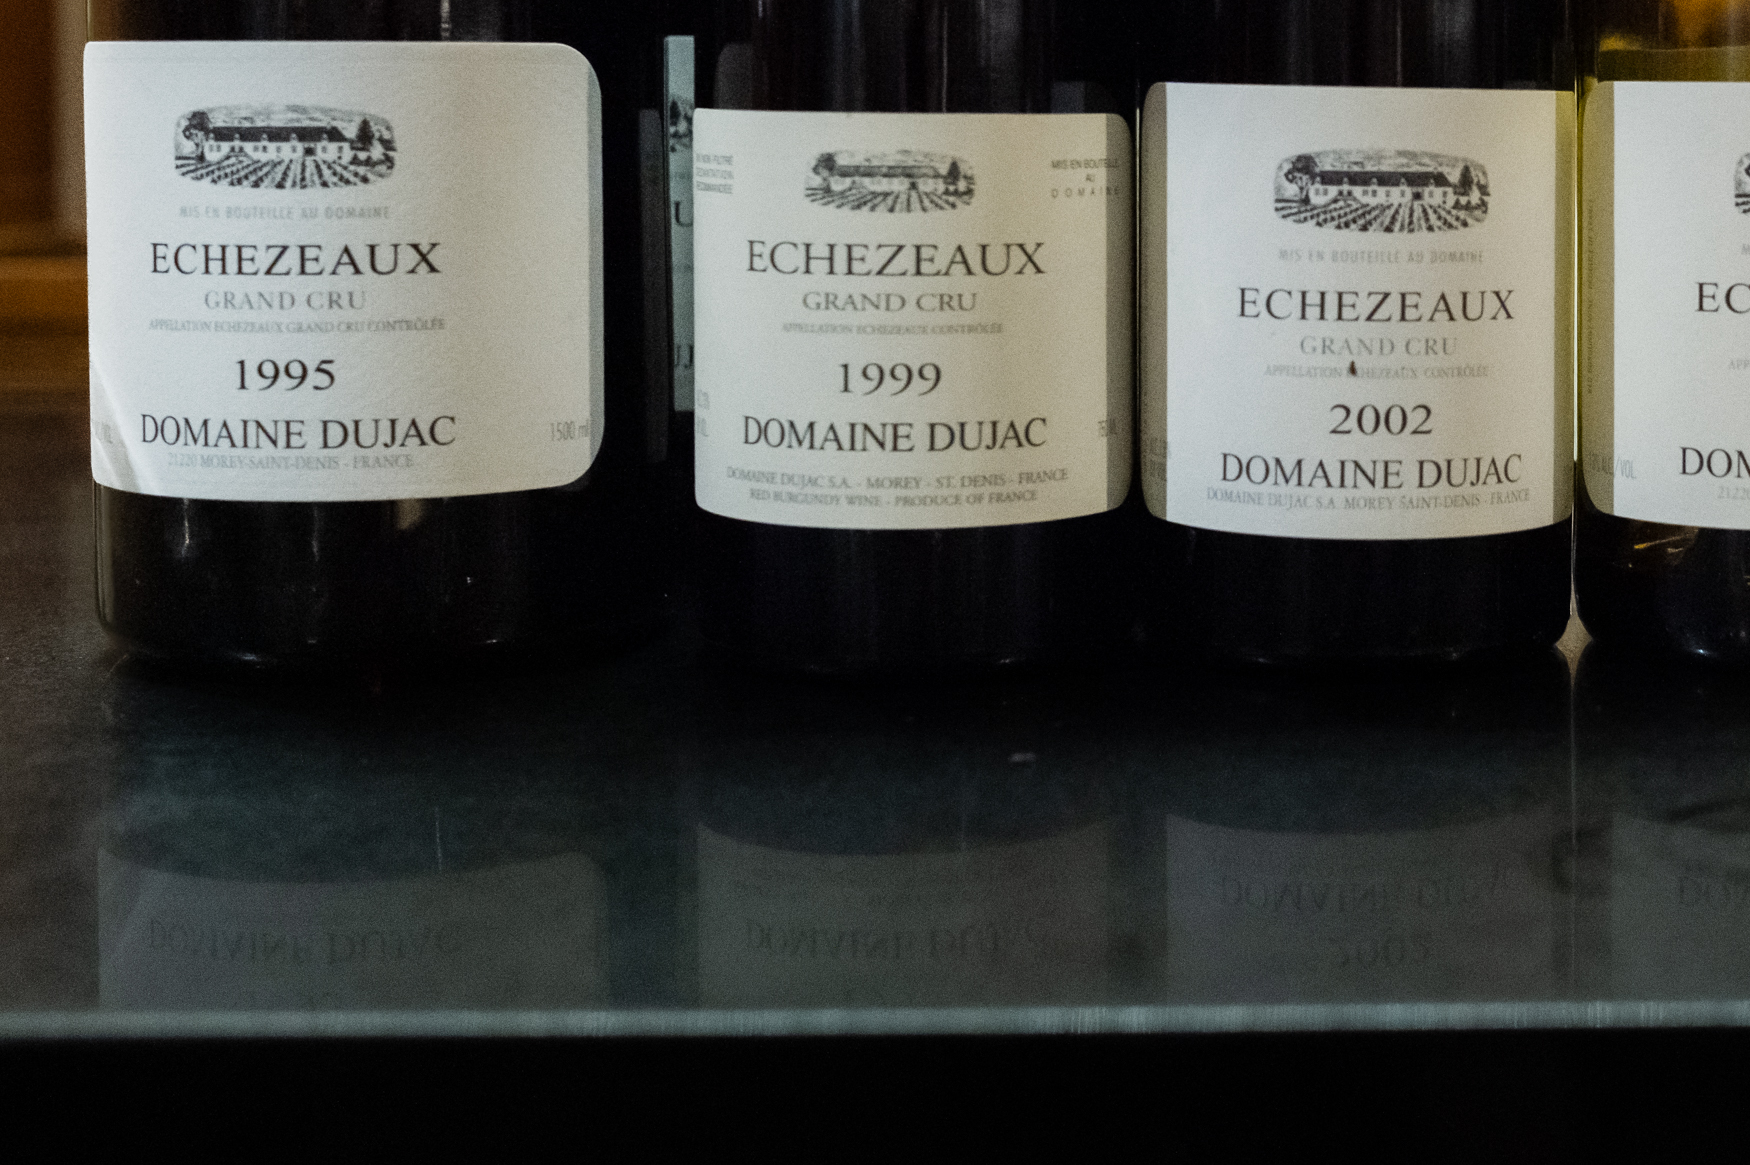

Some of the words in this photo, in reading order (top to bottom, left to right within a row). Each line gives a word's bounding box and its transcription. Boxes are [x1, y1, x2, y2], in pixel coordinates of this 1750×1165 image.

[150, 242, 441, 275] ECHEZEAUX
[746, 239, 1046, 276] ECHEZEAUX
[1279, 248, 1302, 262] MIS
[1331, 249, 1400, 264] BOUTEILLE
[1430, 250, 1484, 264] DOMAINE
[204, 289, 296, 311] GRAND
[306, 289, 367, 311] CRU
[802, 291, 907, 312] GRAND
[915, 292, 977, 312] CRU
[1238, 287, 1515, 323] ECHEZEAUX
[1300, 335, 1395, 357] GRAND
[1404, 336, 1457, 357] CRU
[236, 359, 337, 391] 1995
[839, 362, 942, 396] 1999
[140, 413, 306, 450] DOMAINE
[321, 415, 456, 450] DUJAC
[743, 416, 915, 453] DOMAINE
[927, 417, 1047, 453] DUJAC
[1329, 403, 1433, 436] 2002
[353, 453, 414, 469] FRANCE
[1221, 452, 1404, 490] DOMAINE
[1416, 453, 1524, 490] DUJAC
[726, 465, 777, 487] DOMAINE
[781, 471, 825, 490] DUJAC
[867, 476, 921, 491] MOREY
[960, 473, 1006, 489] DENIS
[1018, 467, 1069, 486] FRANCE
[750, 488, 771, 502] RED
[846, 493, 881, 507] WINE
[966, 492, 986, 506] OF
[988, 488, 1037, 505] FRANCE
[1206, 486, 1264, 506] DOMAINE
[1267, 492, 1314, 511] DUJAC
[1344, 496, 1395, 511] MOREY
[1489, 487, 1531, 507] FRANCE
